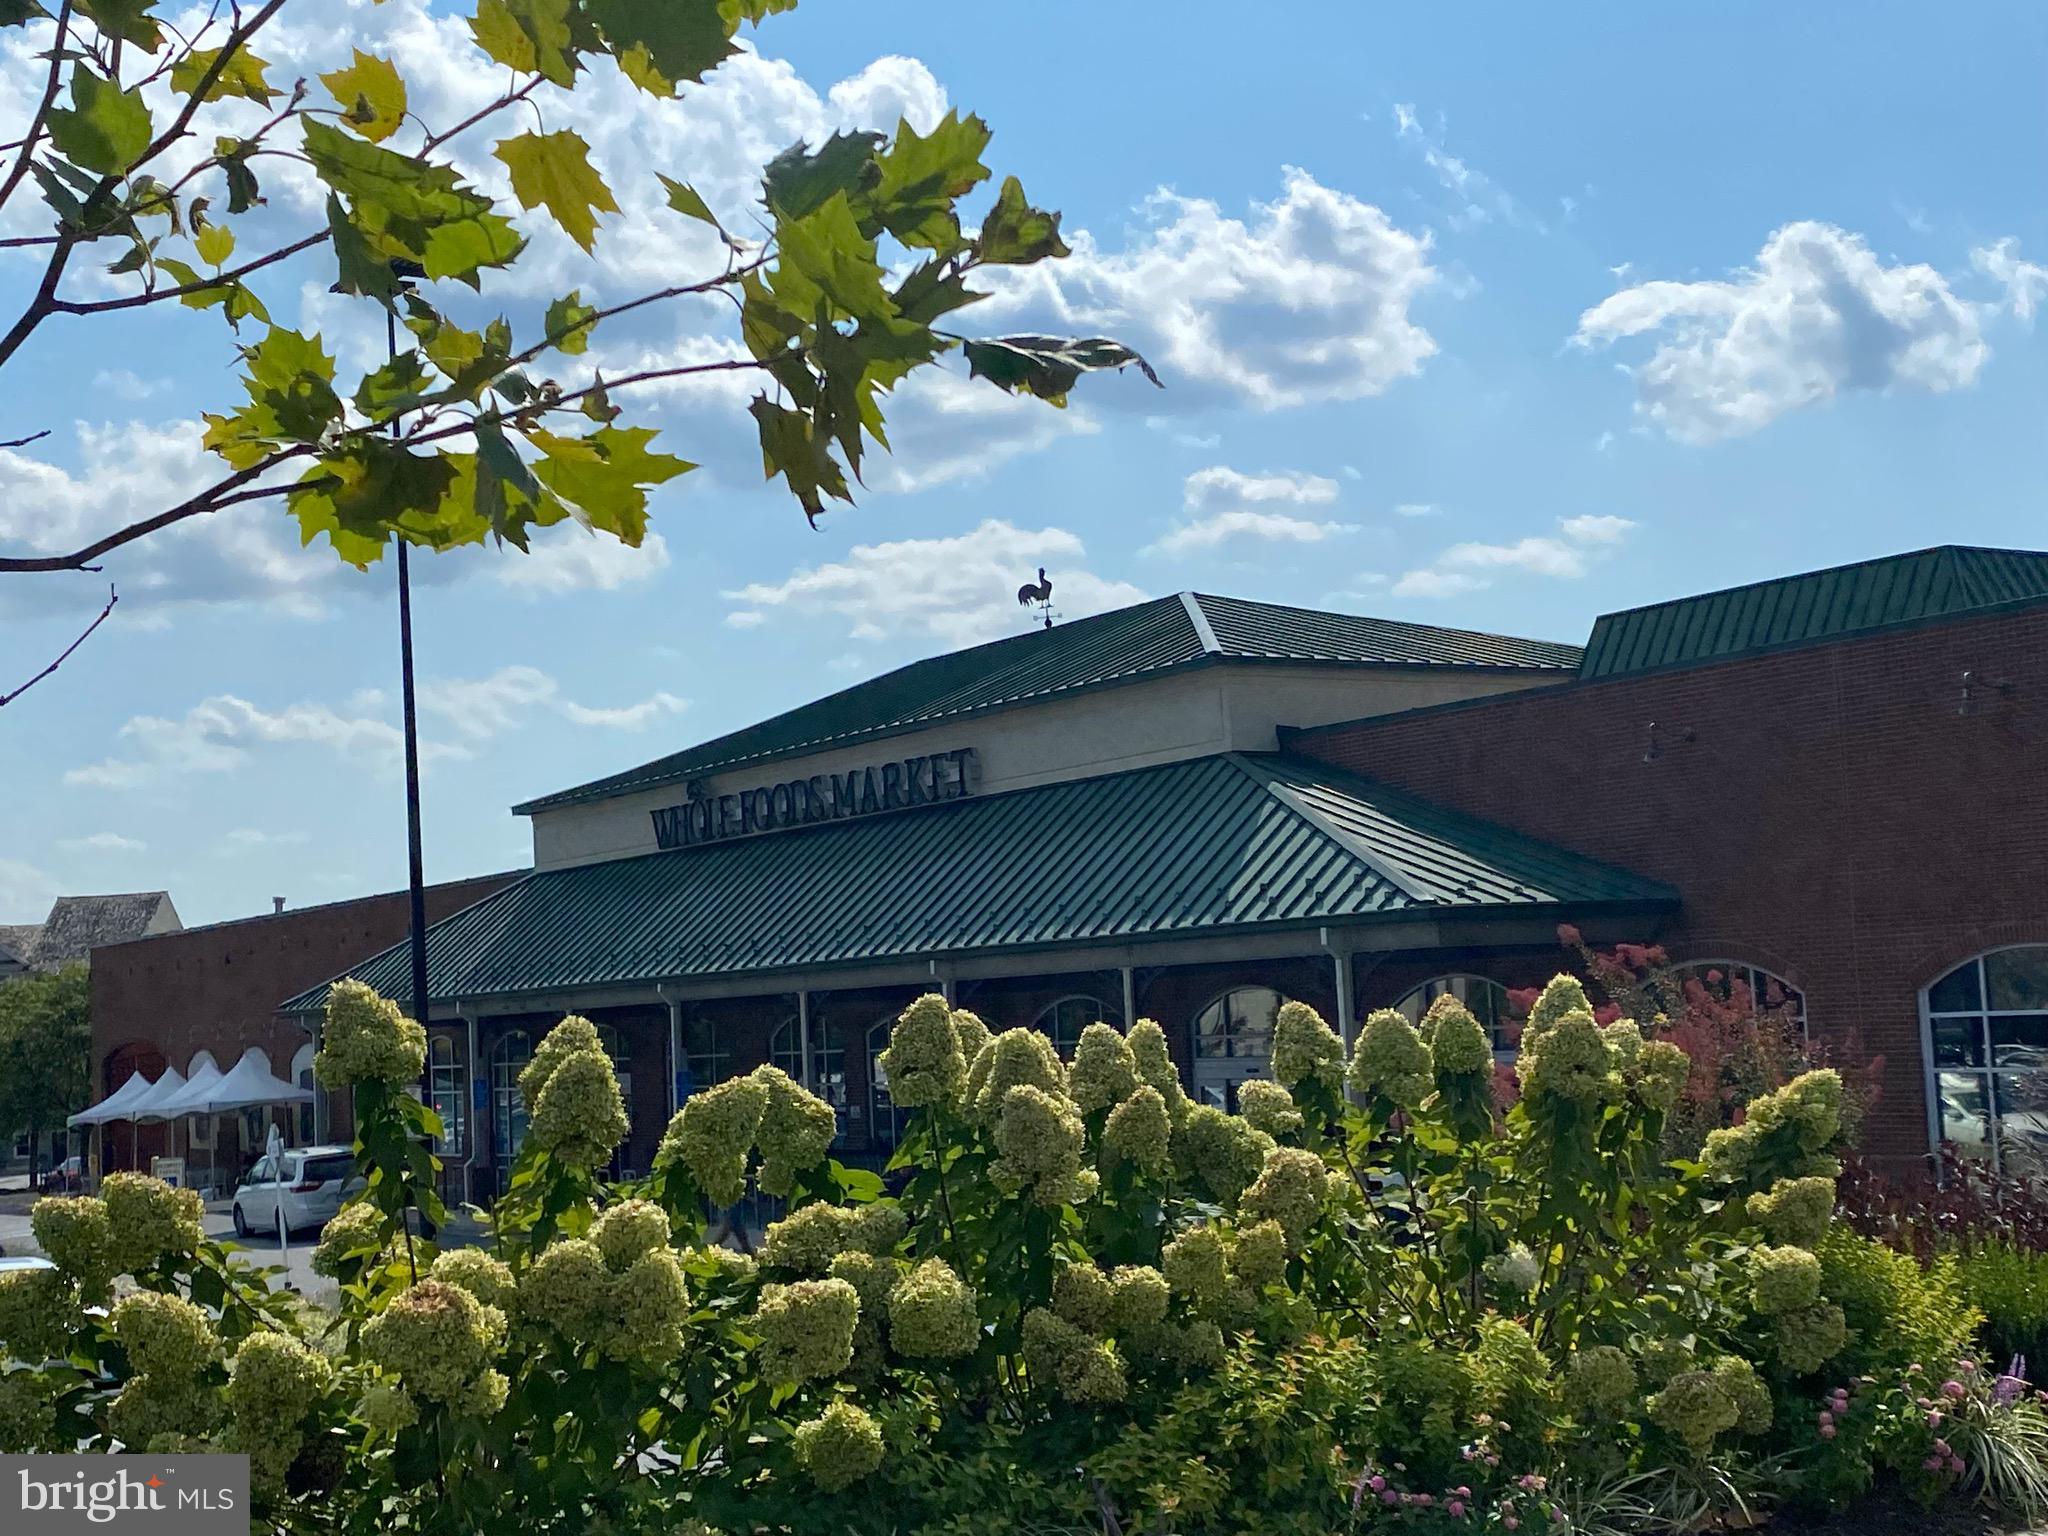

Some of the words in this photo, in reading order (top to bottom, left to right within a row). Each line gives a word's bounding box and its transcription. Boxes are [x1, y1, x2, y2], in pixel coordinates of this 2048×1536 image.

[650, 794, 742, 850] WHOLE
[739, 775, 827, 834] FOODS
[829, 747, 978, 819] MARKET
